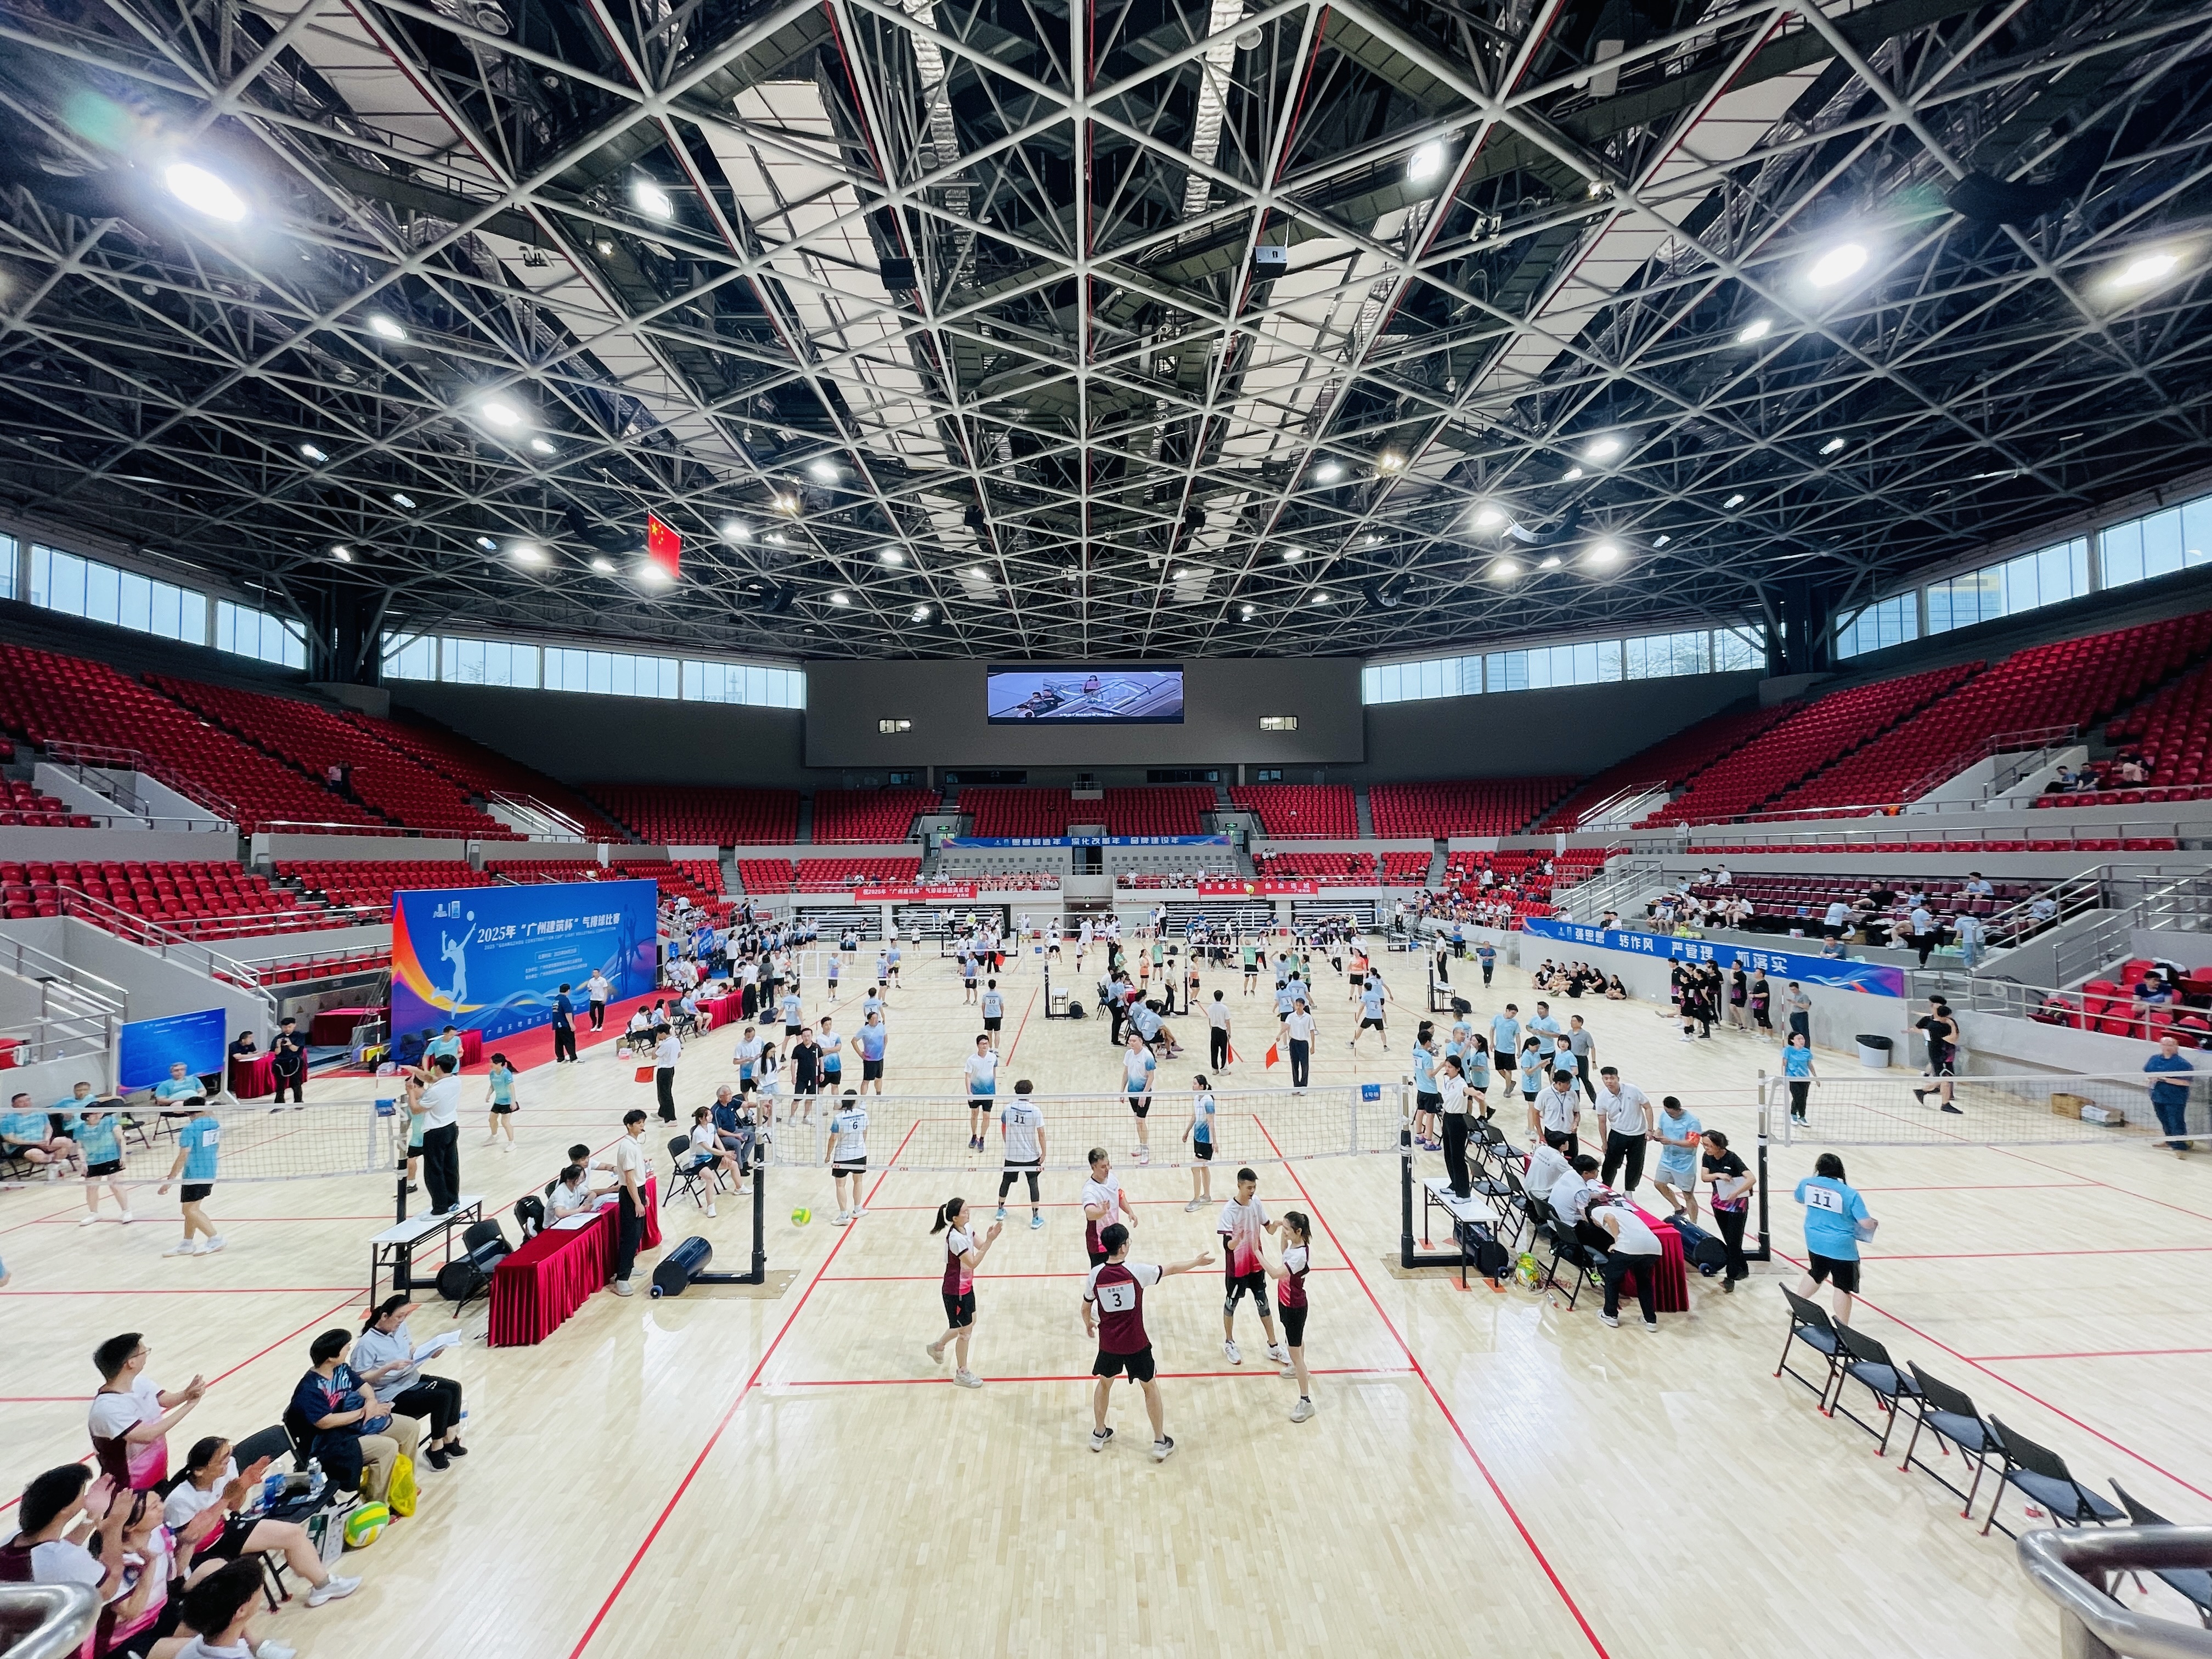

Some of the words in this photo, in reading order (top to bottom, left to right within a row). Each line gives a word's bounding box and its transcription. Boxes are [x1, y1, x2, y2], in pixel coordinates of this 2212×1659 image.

[1130, 837, 1179, 845] 品牌建设年
[1575, 927, 1605, 944] 强思想
[1619, 934, 1654, 952] 转作风
[1672, 941, 1713, 961] 严管理
[1735, 950, 1787, 974] 抓落实
[1014, 1115, 1025, 1124] 11
[853, 1121, 858, 1130] 6
[1812, 1193, 1832, 1208] 11
[1113, 1293, 1122, 1307] 3
